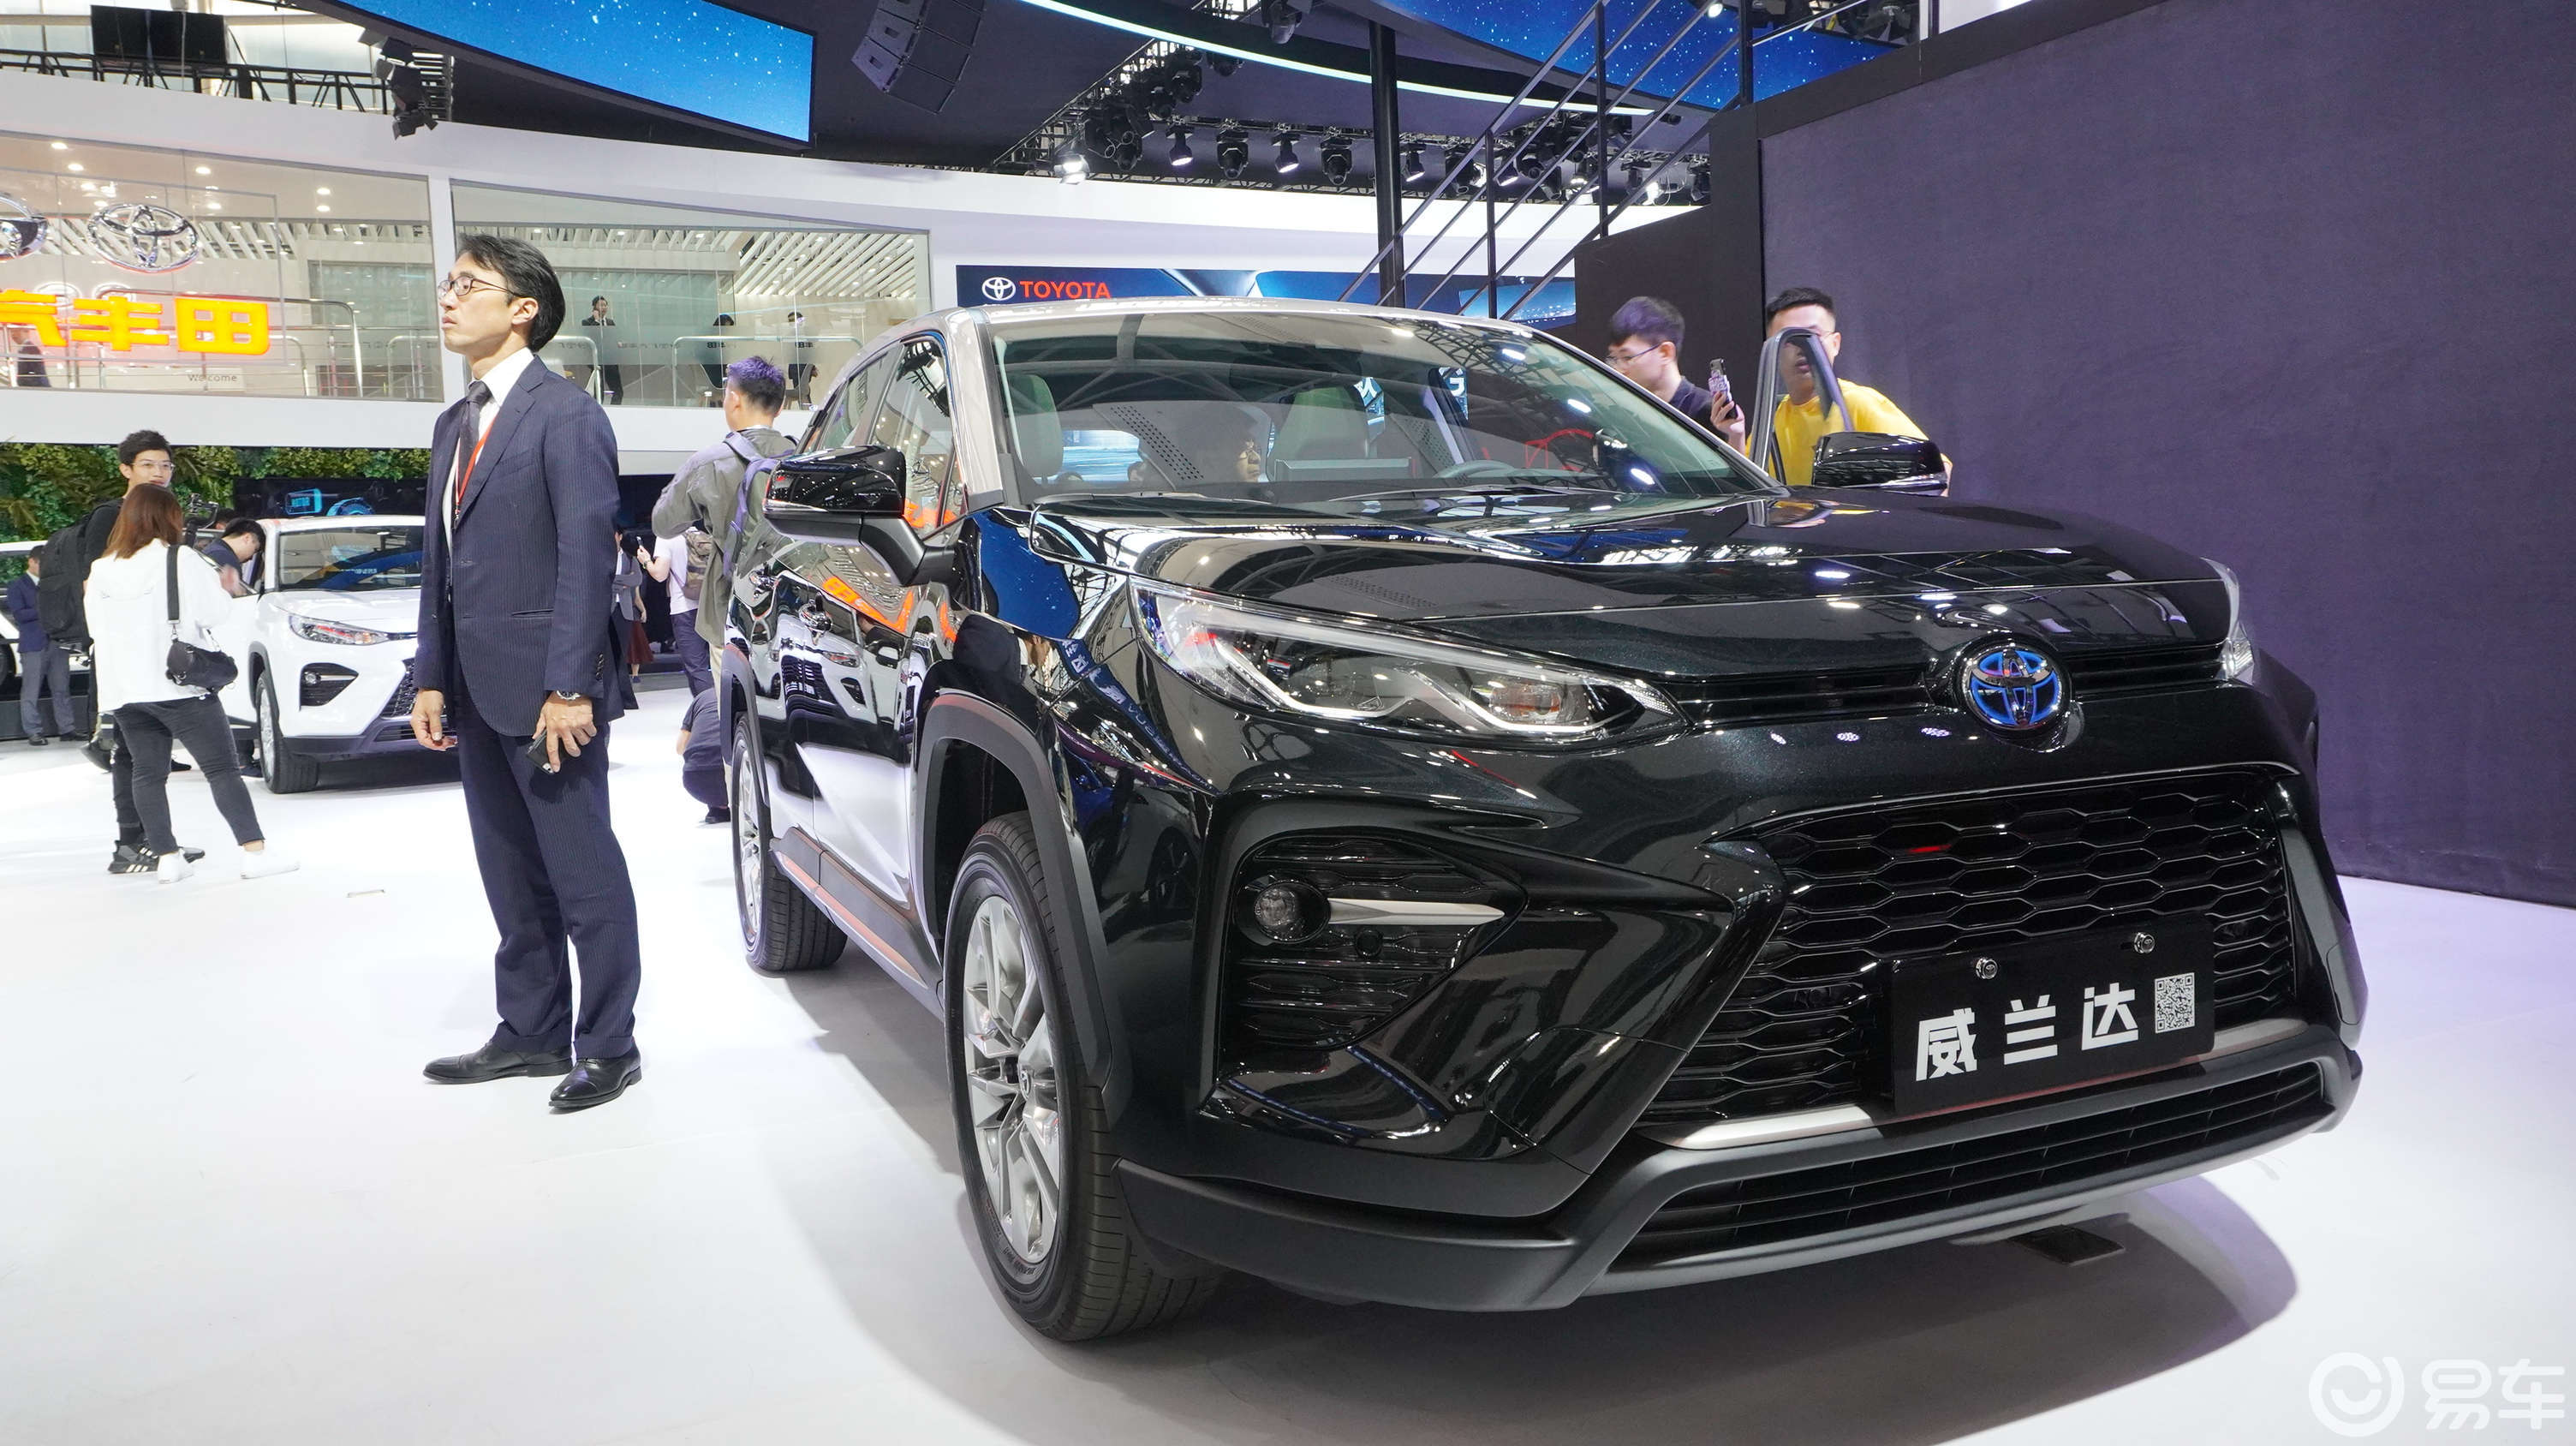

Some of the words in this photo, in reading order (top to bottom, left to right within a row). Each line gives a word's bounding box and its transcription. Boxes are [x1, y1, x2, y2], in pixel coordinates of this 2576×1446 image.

[1020, 280, 1111, 299] TOYOTA
[188, 373, 238, 382] Wecome
[1916, 983, 2139, 1081] 威兰达
